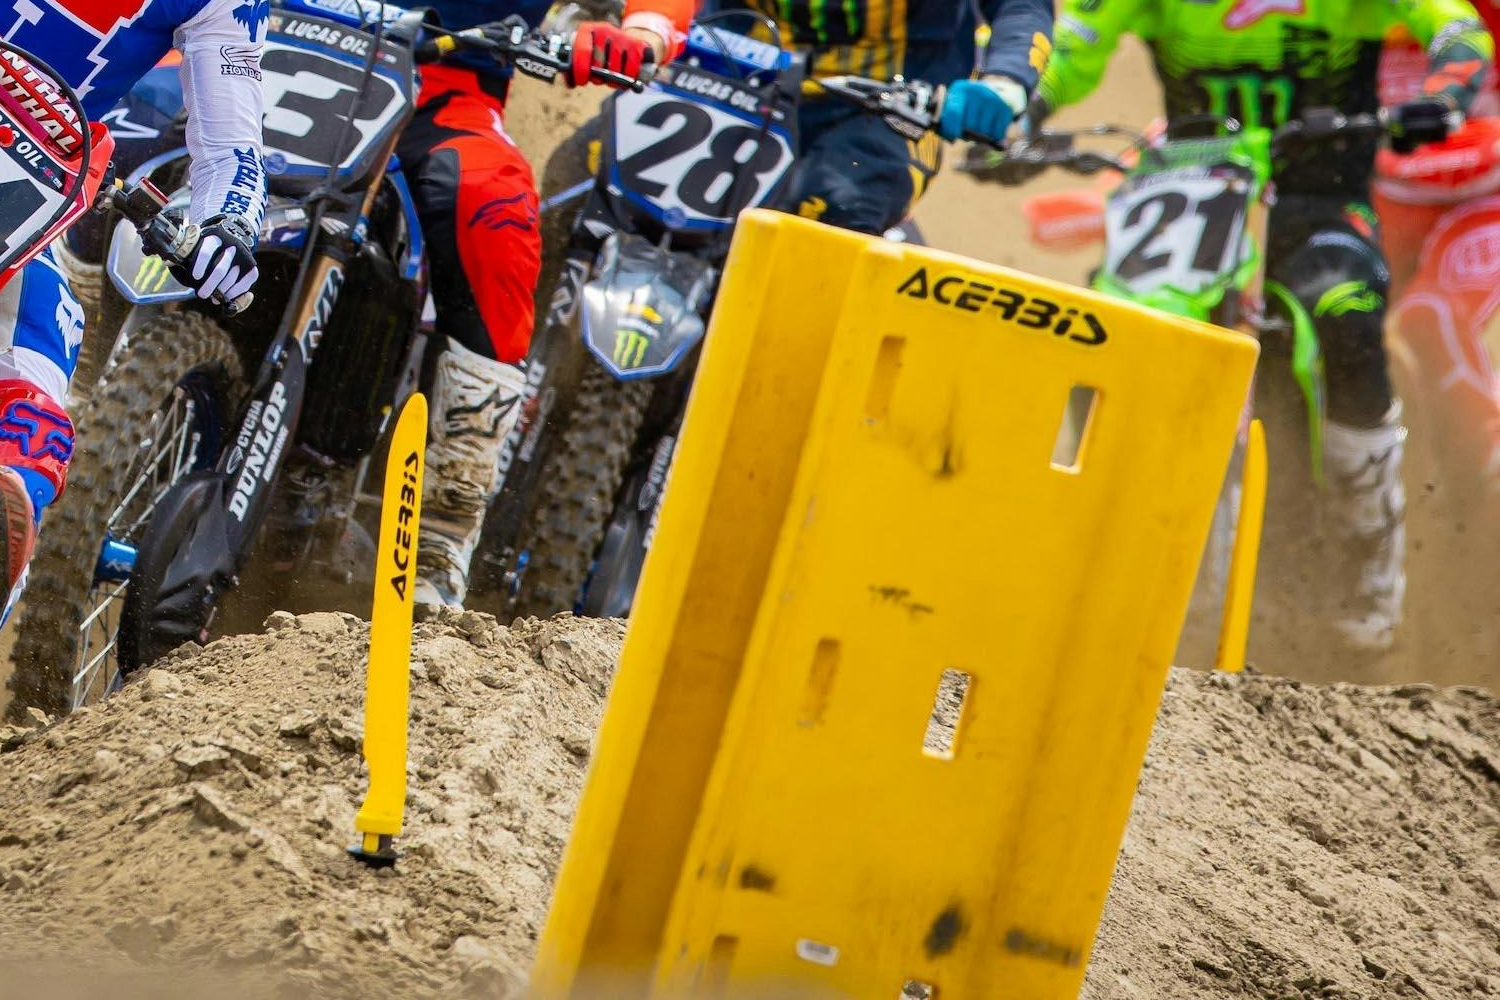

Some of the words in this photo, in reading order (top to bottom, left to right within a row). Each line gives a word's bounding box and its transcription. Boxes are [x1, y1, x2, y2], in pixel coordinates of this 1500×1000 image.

[284, 19, 339, 46] LUCAS
[339, 31, 369, 56] OIL
[259, 48, 397, 167] 3
[674, 72, 733, 100] LUCAS
[16, 140, 46, 167] OIL
[617, 100, 784, 219] 28
[1114, 192, 1248, 281] 21
[896, 266, 1109, 347] ACERBIS
[228, 380, 288, 522] DUNLOP
[236, 399, 263, 449] CYCRA
[390, 451, 418, 602] ACERBIS
